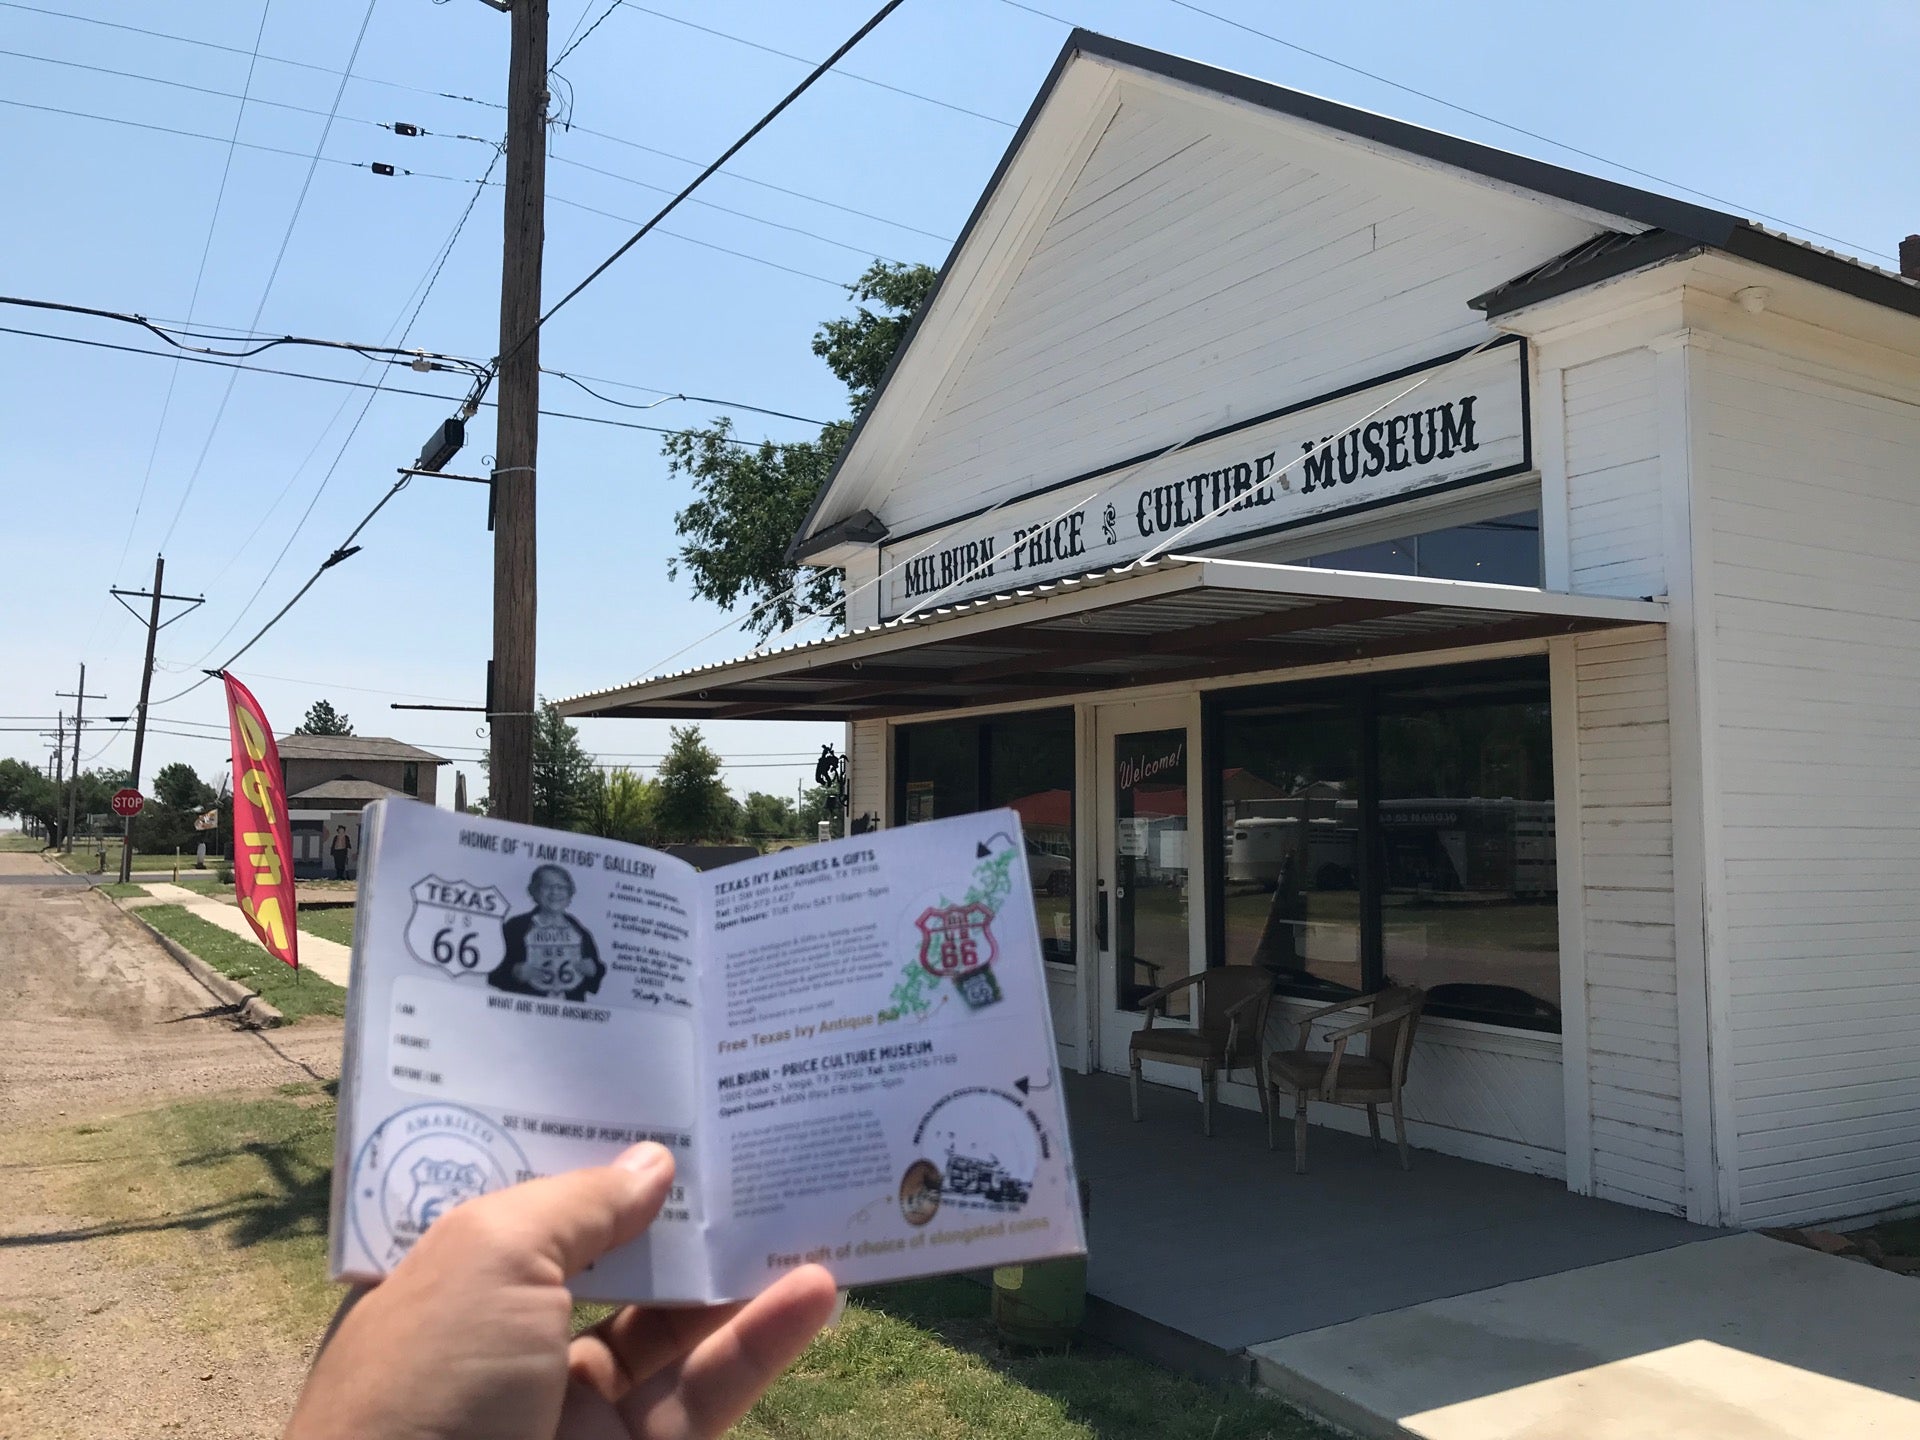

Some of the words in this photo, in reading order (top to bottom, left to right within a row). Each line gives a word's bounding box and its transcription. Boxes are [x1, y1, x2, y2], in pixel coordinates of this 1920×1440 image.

[905, 536, 995, 598] MILBURN
[1013, 511, 1086, 571] PRICE
[1136, 451, 1276, 537] CULTURE
[1301, 396, 1480, 494] MUSEUM
[1120, 743, 1182, 789] Welcome!
[113, 796, 142, 809] STOP
[459, 829, 499, 851] HOME
[501, 837, 519, 854] OF
[536, 843, 558, 861] AM
[602, 854, 657, 879] GALLERY
[714, 876, 751, 896] TEXAS
[752, 871, 769, 886] IVY
[773, 858, 828, 881] ANTIQUES
[842, 848, 875, 866] GIFTS
[426, 882, 497, 912] TEXAS
[432, 927, 480, 969] 66
[941, 940, 978, 969] 66
[516, 1000, 533, 1014] ARE
[717, 1038, 749, 1053] Free
[752, 1029, 791, 1046] Texas
[795, 1023, 815, 1039] Ivy
[819, 1012, 874, 1034] Antique
[718, 1066, 770, 1090] MILBURN
[782, 1057, 819, 1077] PRICE
[821, 1048, 876, 1070] CULTURE
[880, 1039, 933, 1060] MUSEUM
[767, 1252, 801, 1268] Free
